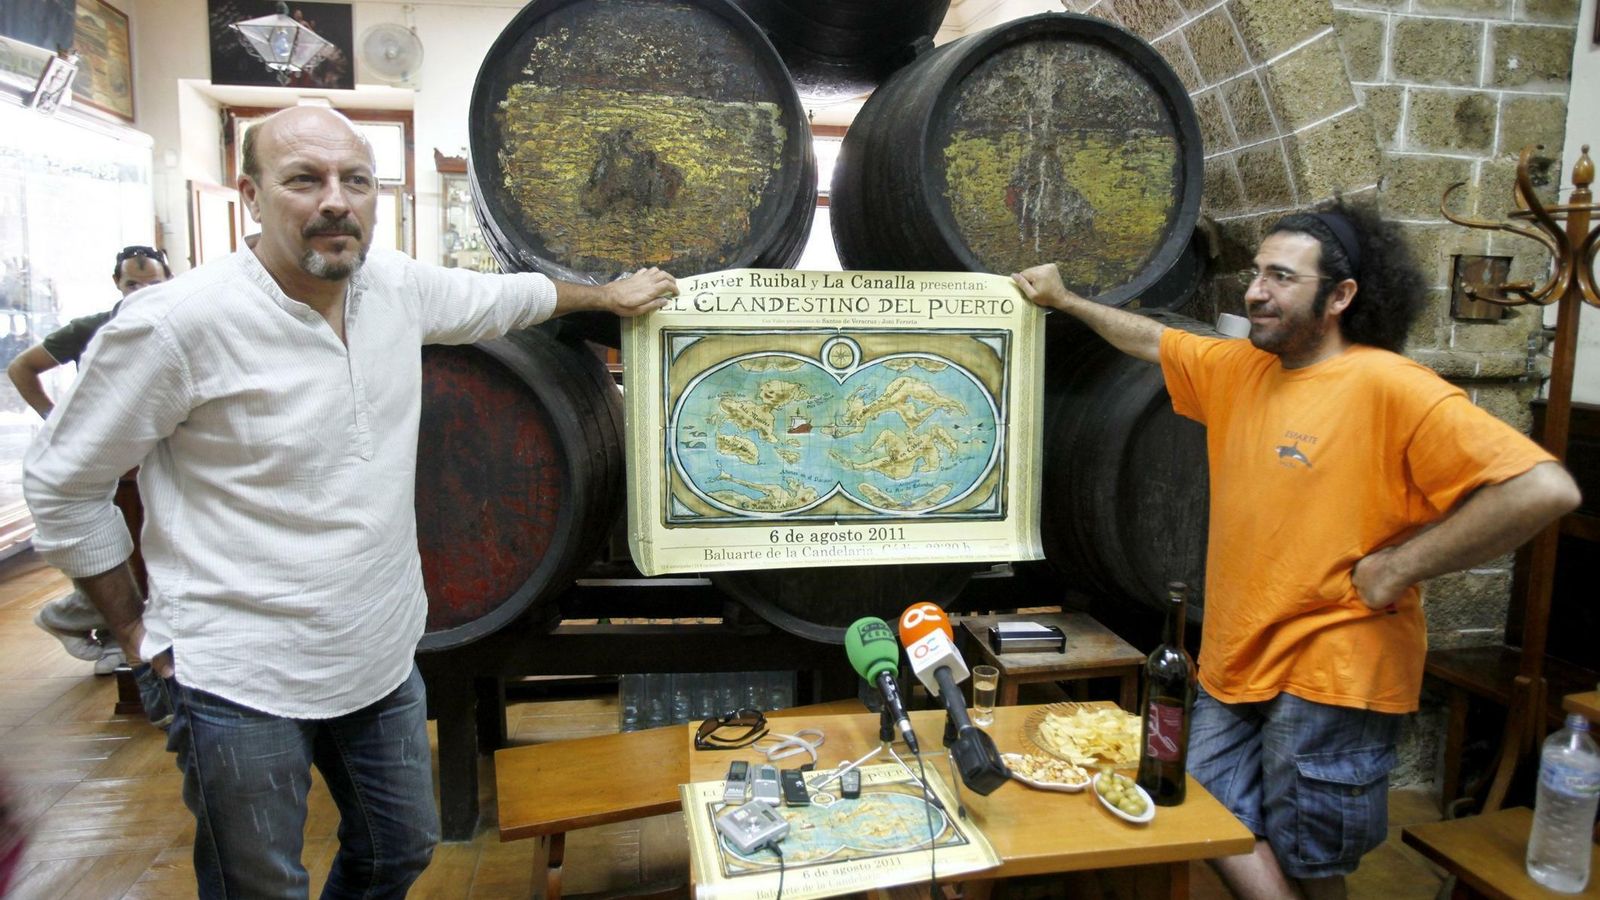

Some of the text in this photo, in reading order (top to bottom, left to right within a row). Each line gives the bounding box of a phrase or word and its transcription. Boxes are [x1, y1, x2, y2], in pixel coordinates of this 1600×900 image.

[690, 272, 988, 292] Javier Ruibal y La Canalla presentan:
[694, 292, 870, 313] CLANDESTINO
[878, 298, 922, 314] DEL
[928, 298, 1015, 320] PUERTO
[769, 527, 906, 545] 6 de agosto 2011
[704, 548, 763, 561] Baluarte
[766, 547, 782, 560] de
[785, 546, 797, 558] la
[802, 543, 873, 558] Candelaria
[802, 856, 902, 879] 6 de agosto 2011
